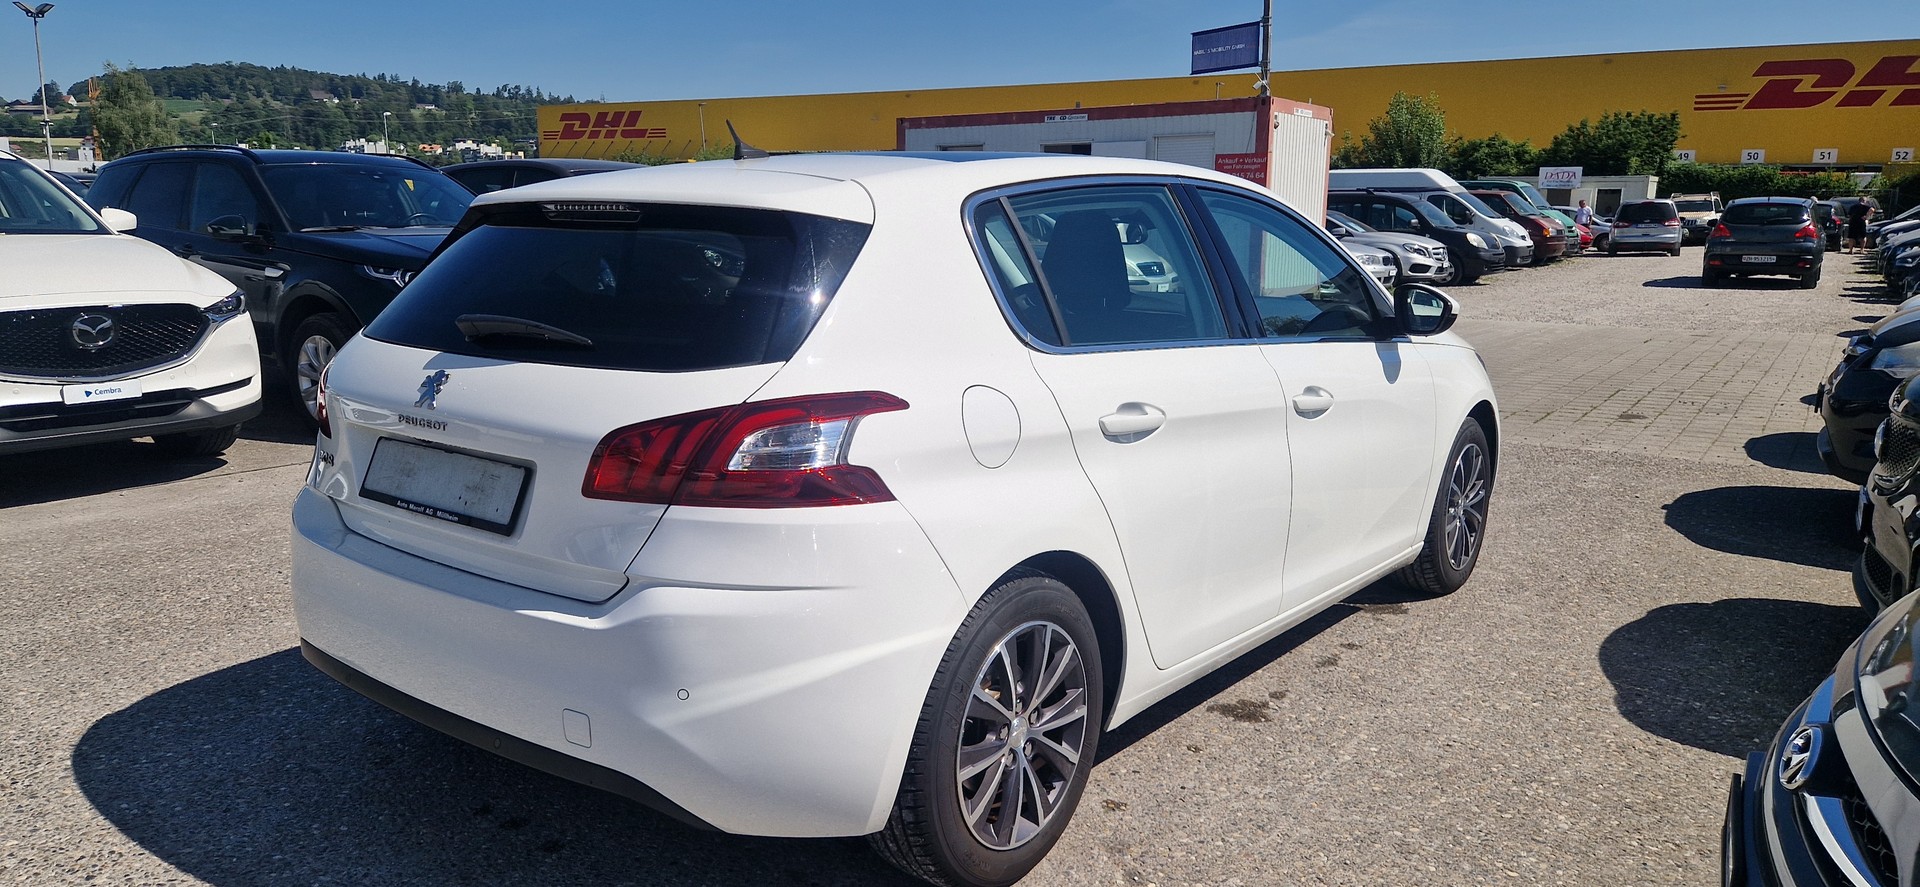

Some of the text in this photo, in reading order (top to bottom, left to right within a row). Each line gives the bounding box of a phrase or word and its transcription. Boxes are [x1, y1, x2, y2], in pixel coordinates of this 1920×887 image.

[1211, 45, 1231, 53] MOBILITY
[559, 110, 649, 139] DHL
[1244, 156, 1267, 164] Verkauf
[1746, 152, 1759, 161] 50
[1819, 151, 1832, 161] 51
[1895, 151, 1909, 161] 52
[94, 387, 122, 396] Cembra
[397, 413, 448, 431] PEUGEOT
[396, 500, 408, 509] Auto
[425, 507, 434, 516] AG
